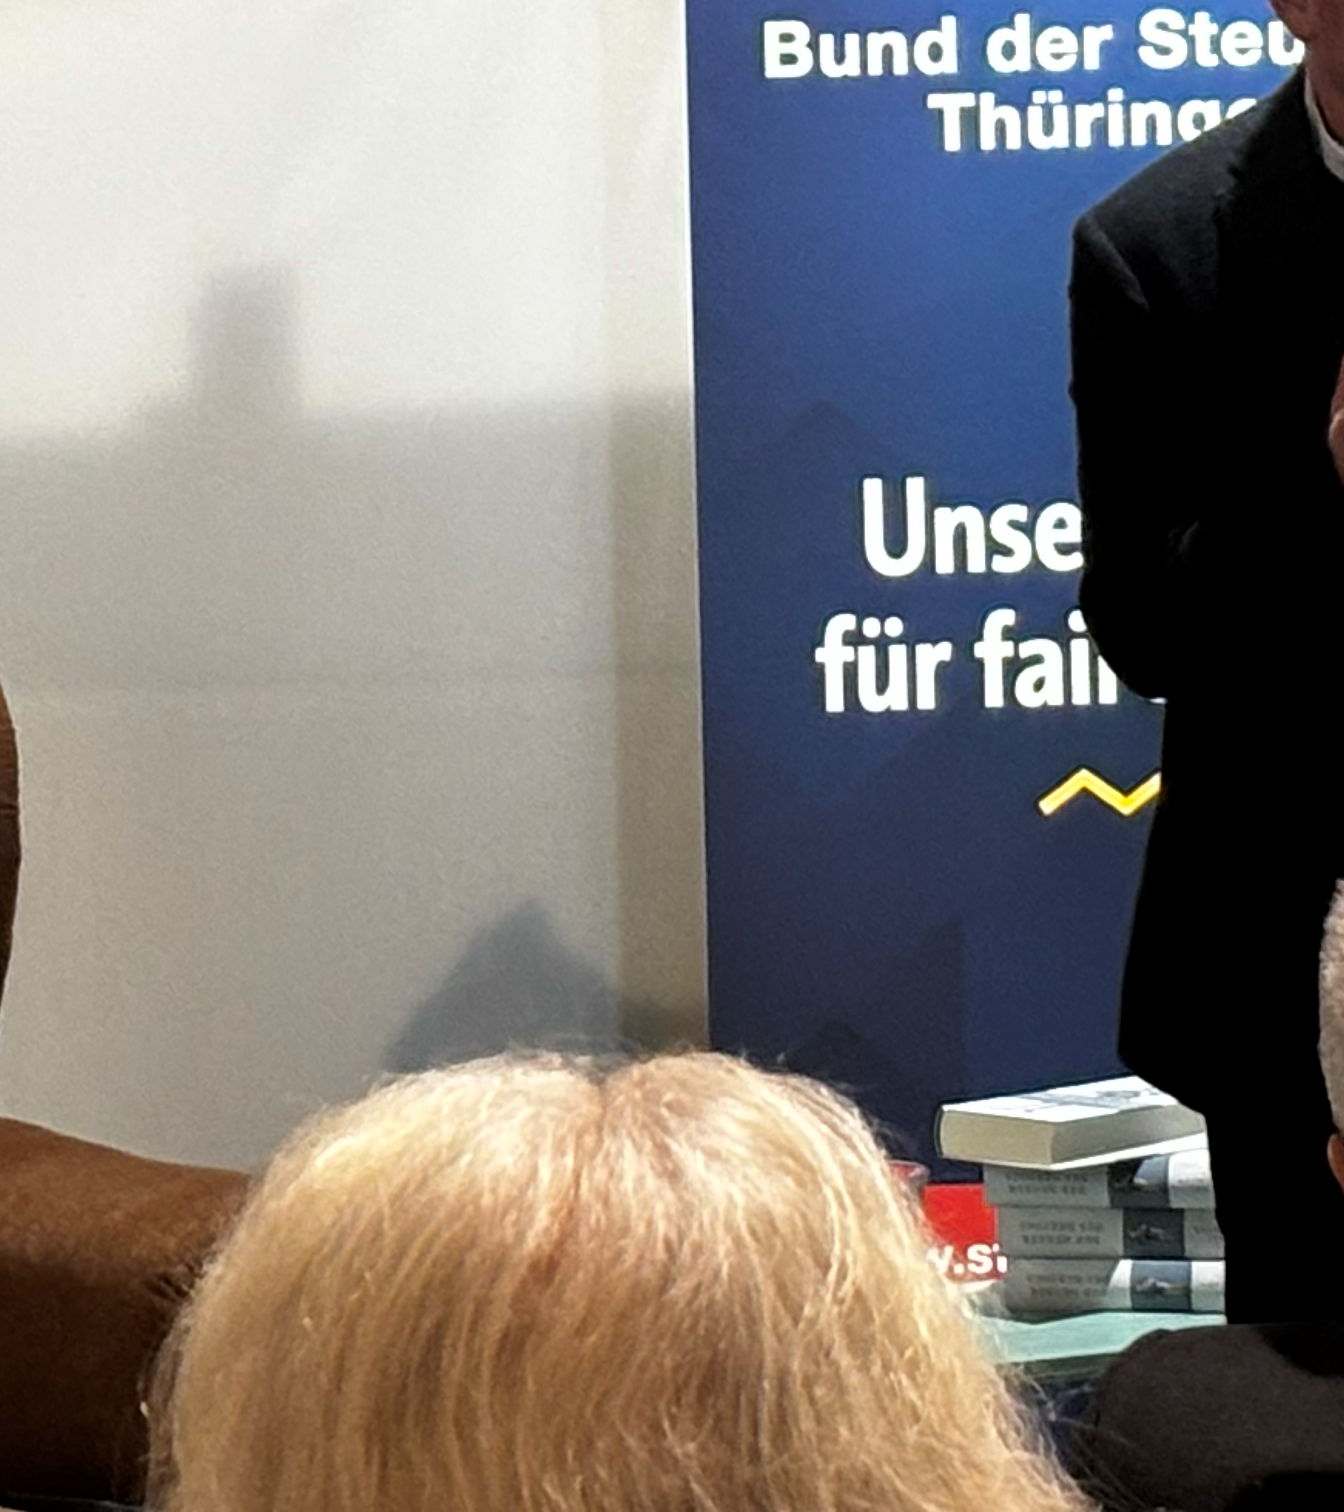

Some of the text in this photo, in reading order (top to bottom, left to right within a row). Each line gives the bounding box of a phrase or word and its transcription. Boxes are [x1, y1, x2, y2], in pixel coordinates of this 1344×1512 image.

[764, 16, 957, 78] Bund
[987, 14, 1113, 73] der
[927, 88, 1256, 151] Thüring
[864, 477, 1083, 576] Unse
[815, 614, 952, 712] für
